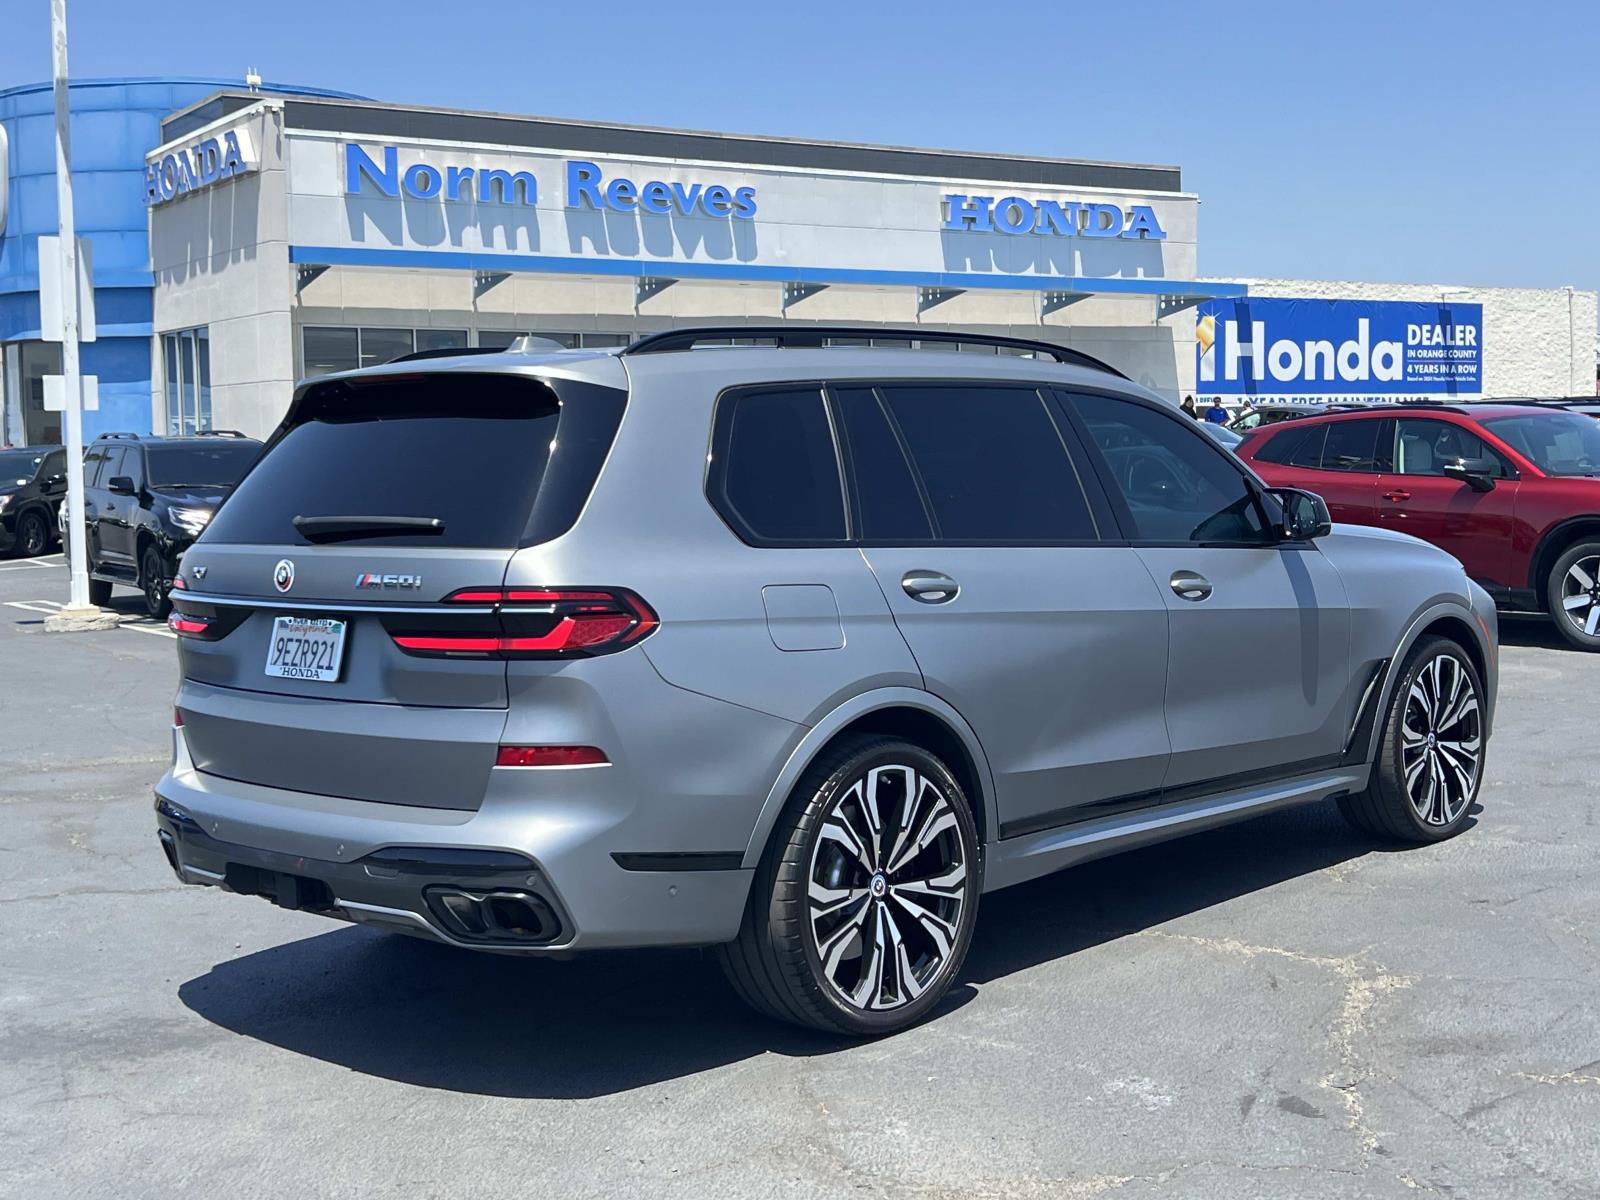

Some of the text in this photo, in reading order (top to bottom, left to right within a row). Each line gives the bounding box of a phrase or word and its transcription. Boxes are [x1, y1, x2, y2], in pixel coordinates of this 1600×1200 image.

[144, 131, 247, 205] HONDA
[345, 143, 758, 218] Norm Reeves
[943, 194, 1167, 239] HONDA
[1225, 318, 1403, 381] Honda
[1407, 324, 1477, 346] DEALER
[1407, 349, 1477, 358] IN ORANGE COUNTY
[1407, 365, 1477, 374] 4 YEARS IN A ROW
[272, 637, 335, 670] 9EZR921
[282, 667, 320, 679] HONDA
